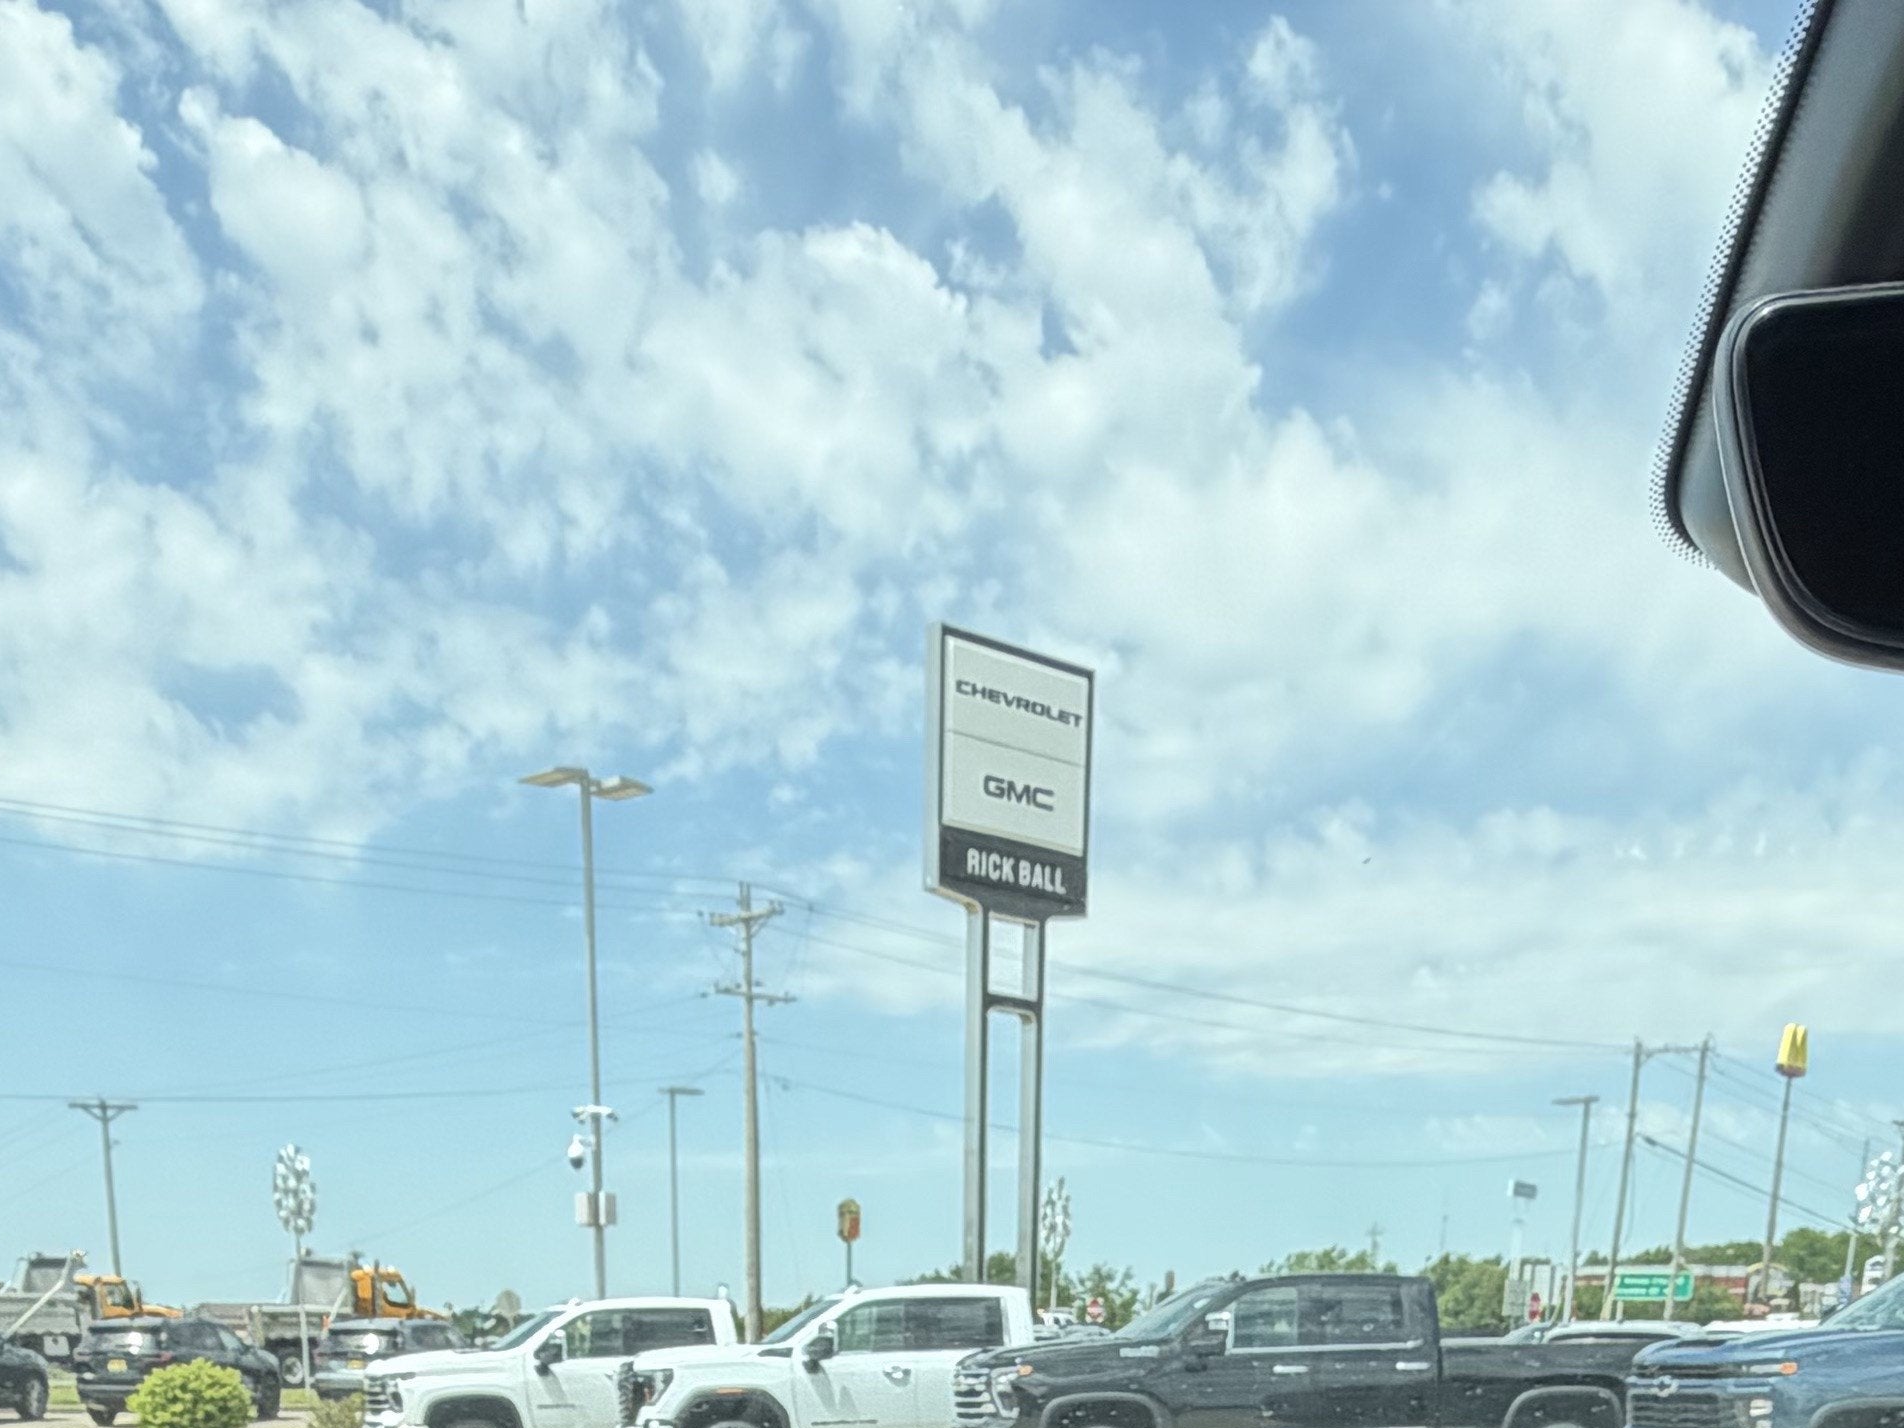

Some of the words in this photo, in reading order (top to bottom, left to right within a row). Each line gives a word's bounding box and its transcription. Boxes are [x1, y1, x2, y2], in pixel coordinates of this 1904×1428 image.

[956, 679, 1083, 728] CHEVROLET
[983, 775, 1055, 812] GMC
[966, 848, 1015, 884] RICK
[1018, 860, 1067, 896] BALL
